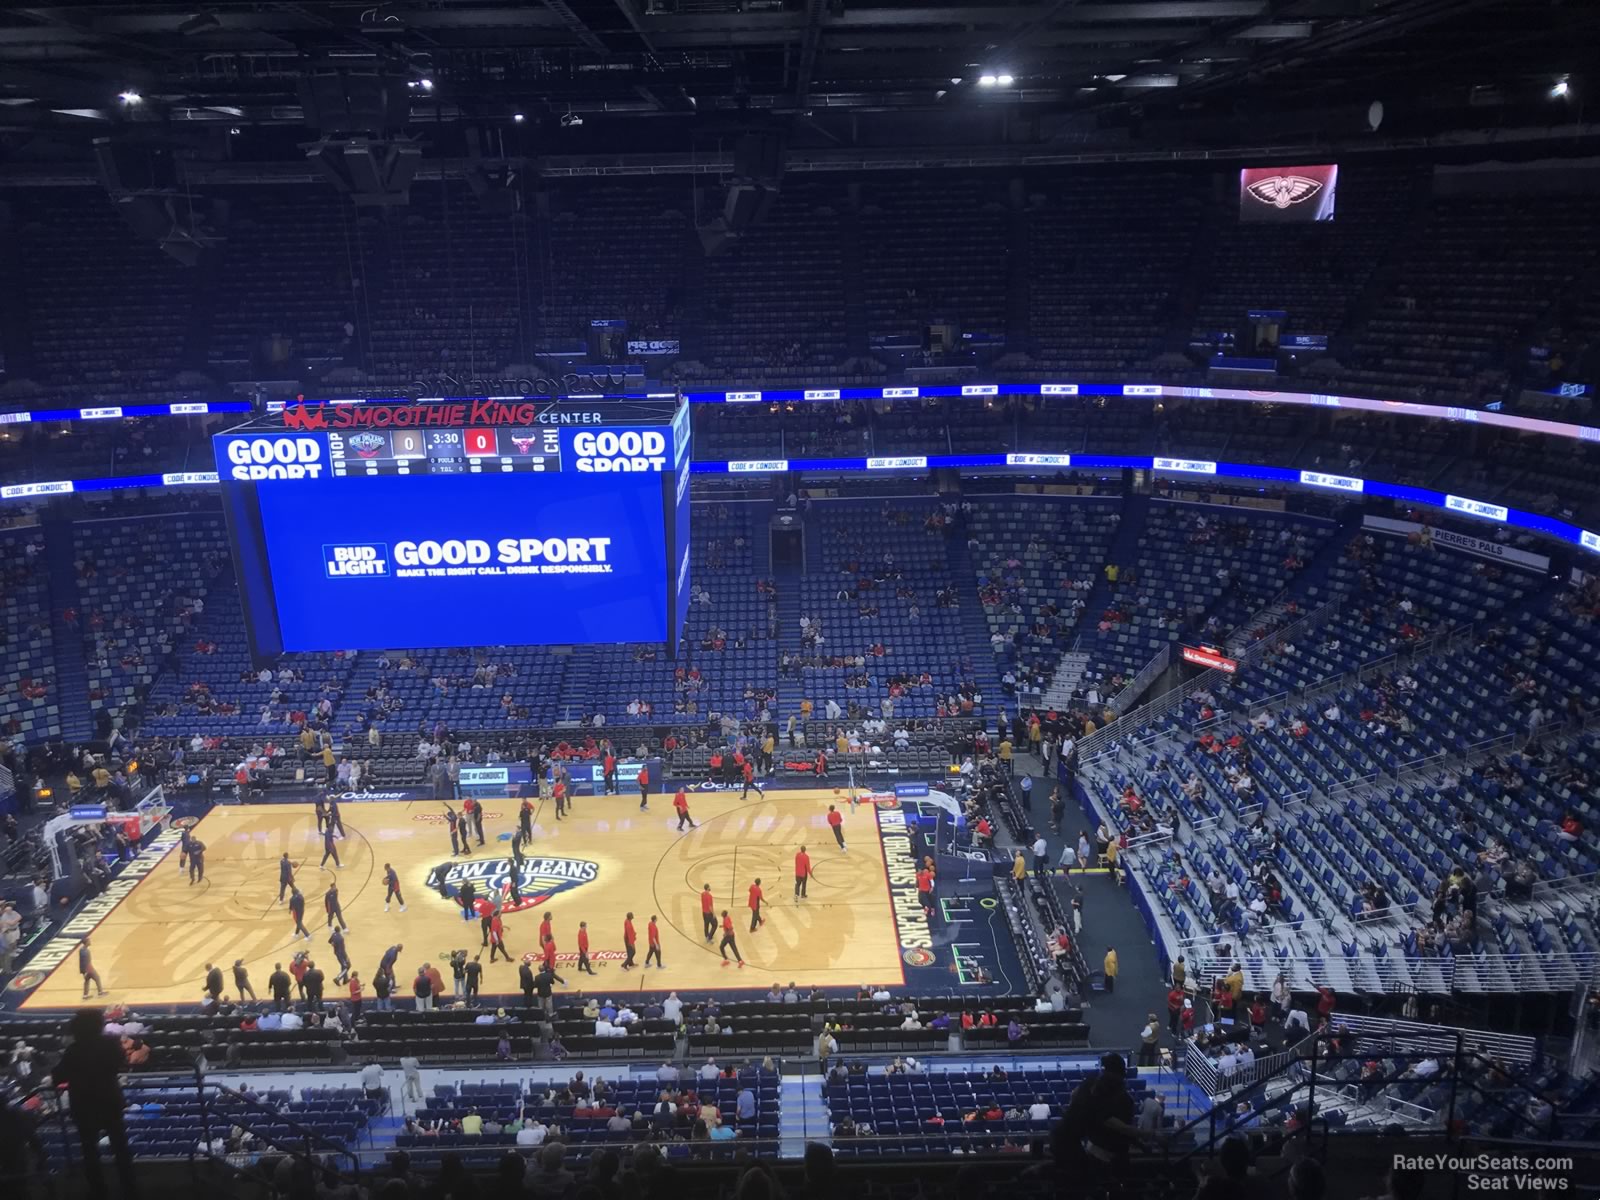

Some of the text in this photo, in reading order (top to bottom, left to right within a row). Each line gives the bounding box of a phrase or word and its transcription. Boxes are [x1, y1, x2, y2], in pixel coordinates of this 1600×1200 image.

[334, 401, 463, 428] SMOOTHIE
[539, 412, 602, 424] CENTER
[330, 432, 344, 458] NOP
[404, 437, 414, 450] 0
[433, 434, 458, 444] 3:30
[476, 436, 486, 449] 0
[543, 430, 558, 452] CHI
[574, 432, 666, 456] GOOD
[228, 438, 320, 464] GOOD
[231, 464, 322, 480] SPORT
[576, 457, 666, 472] SPORT
[194, 473, 219, 481] CONDUC
[334, 546, 376, 561] BUD
[394, 538, 610, 566] GOOD SPORT
[1435, 530, 1503, 555] PIERRE'S PALS
[396, 568, 426, 577] MAKE
[427, 568, 446, 576] THE
[447, 567, 476, 576] RIGHT
[478, 566, 505, 575] CALL.
[507, 566, 539, 574] DRINK
[478, 771, 505, 779] CONDUCT
[342, 791, 406, 799] Ochsner
[878, 810, 908, 833] NEW
[882, 836, 918, 886] ORLEANS
[22, 937, 82, 970] NEW
[62, 879, 140, 934] ORLEANS
[118, 828, 185, 878] PELICANS
[891, 887, 933, 949] PELICANS
